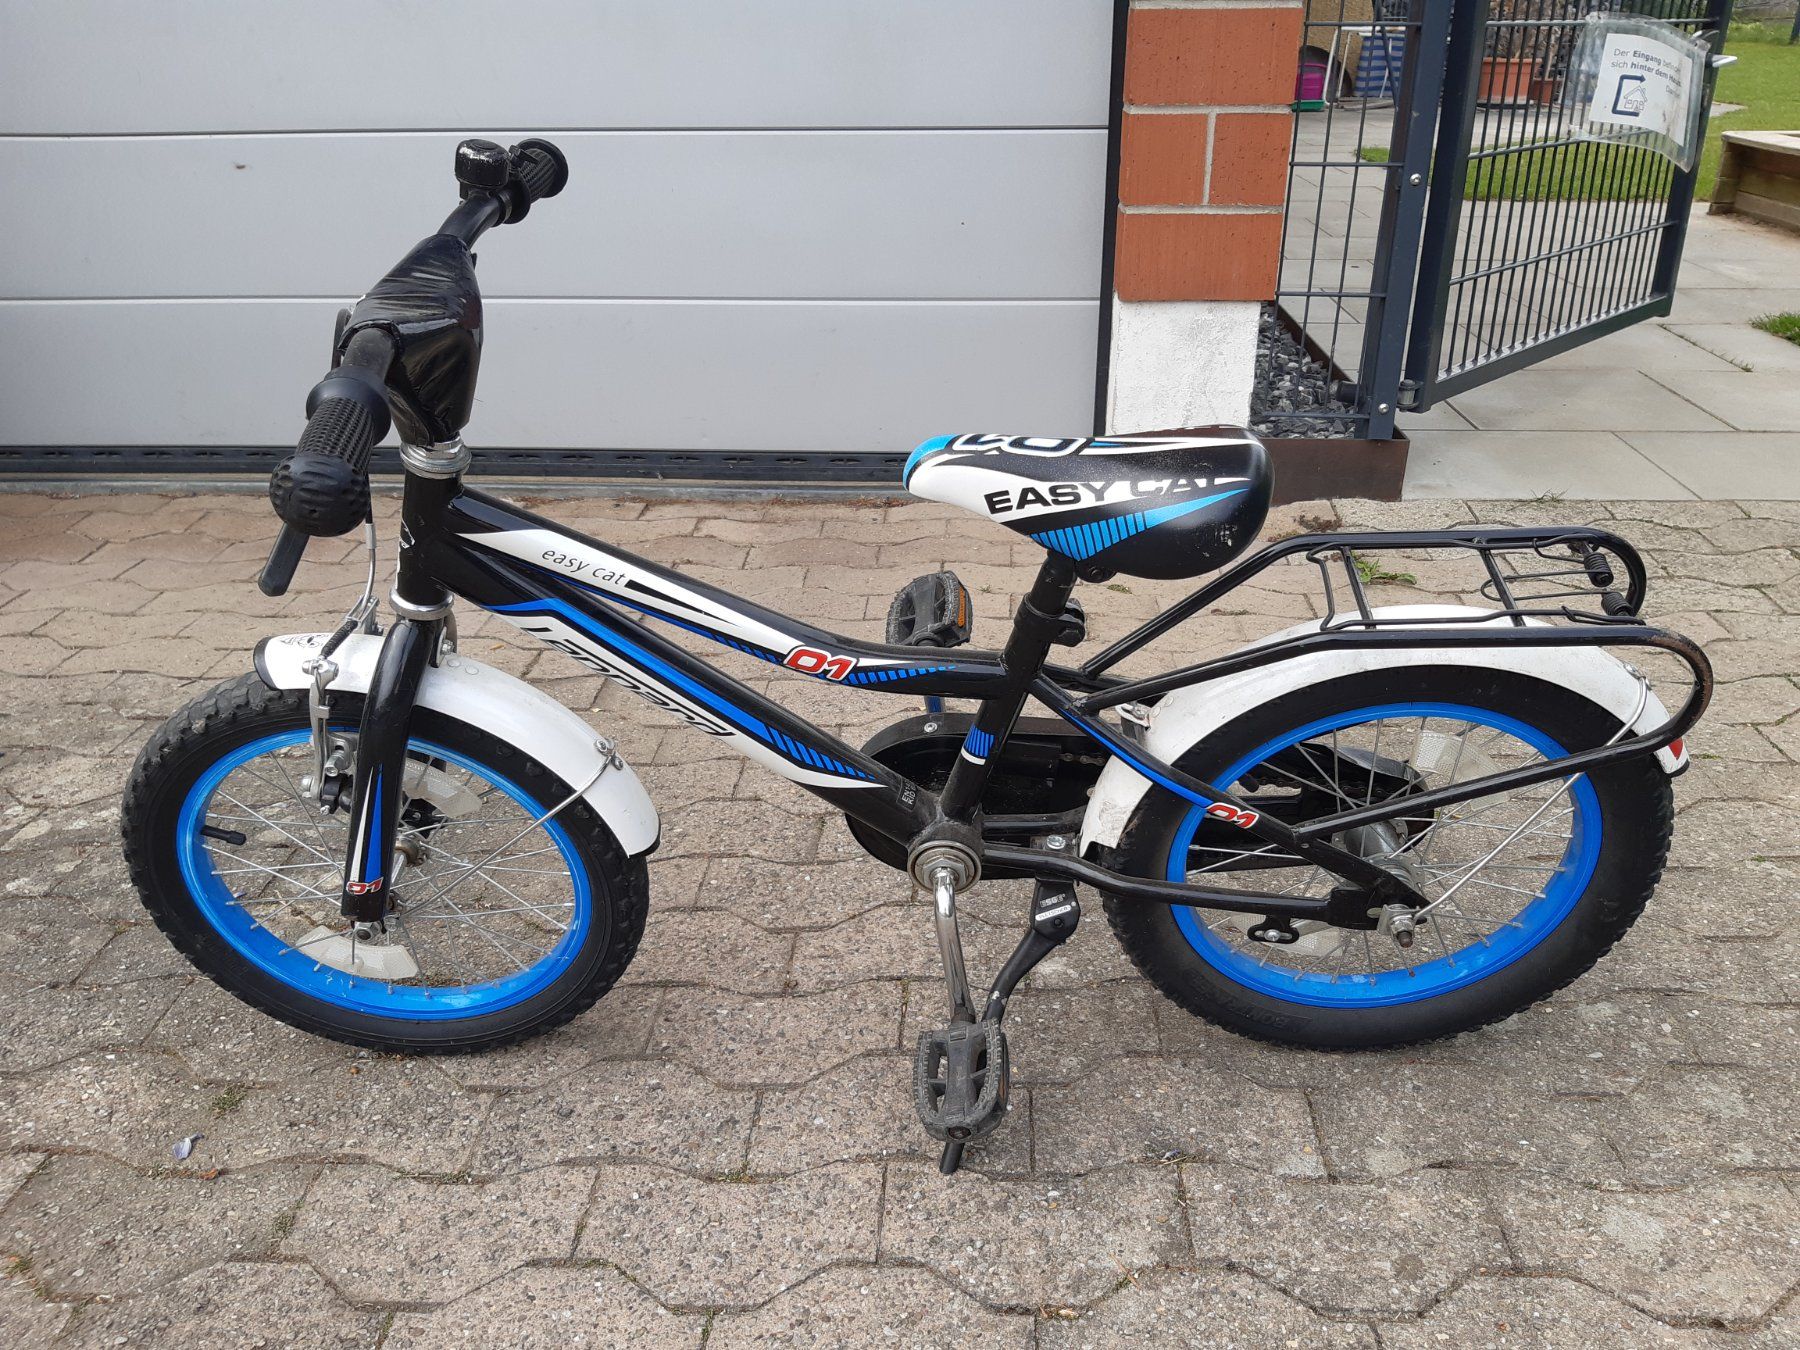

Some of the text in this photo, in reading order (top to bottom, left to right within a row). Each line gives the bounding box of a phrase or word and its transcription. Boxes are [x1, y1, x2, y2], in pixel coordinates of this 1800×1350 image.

[1611, 60, 1628, 69] sich
[1630, 62, 1655, 73] hinter
[1655, 68, 1669, 80] dem
[1614, 48, 1630, 57] Der
[1633, 50, 1662, 65] Eingang
[983, 481, 1117, 516] EASY
[541, 548, 628, 587] easy cat
[782, 643, 860, 683] 01
[1205, 801, 1260, 830] 01
[345, 876, 385, 896] 01
